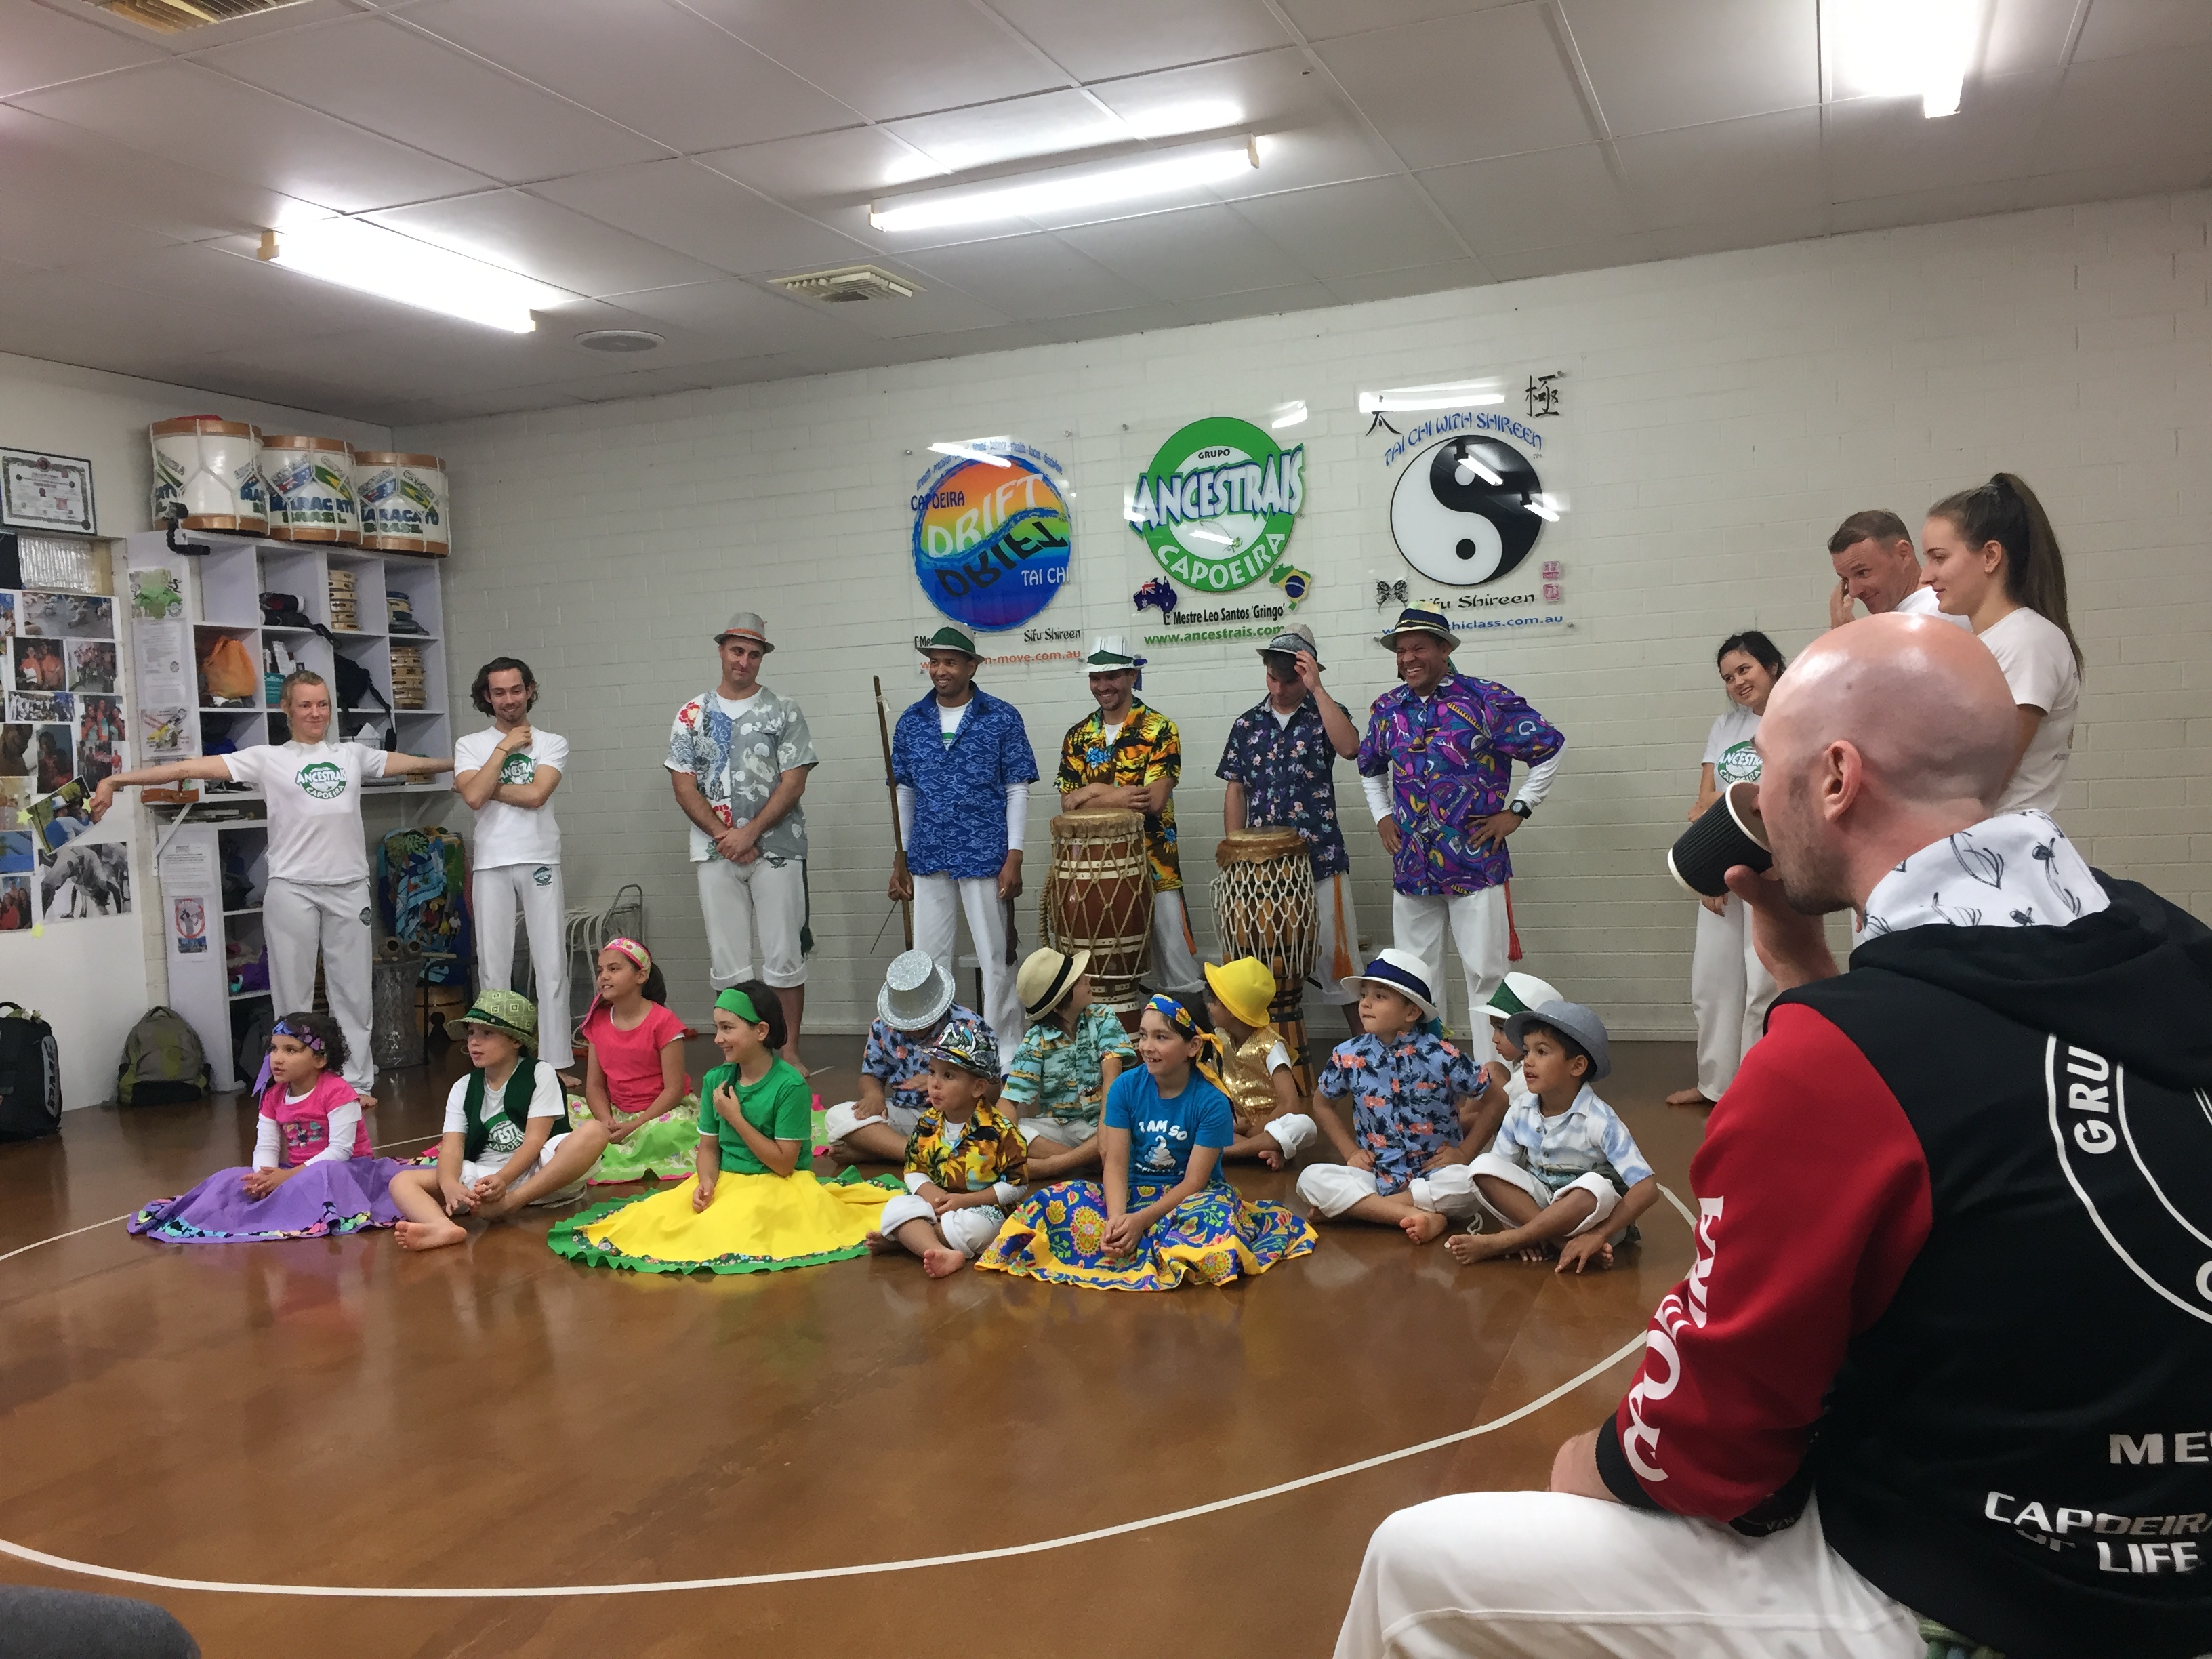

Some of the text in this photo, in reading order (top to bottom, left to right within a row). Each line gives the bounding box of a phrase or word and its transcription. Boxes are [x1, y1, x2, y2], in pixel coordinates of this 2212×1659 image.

[1525, 375, 1559, 417] 極
[1385, 434, 1405, 466] TAI
[1408, 420, 1431, 447] CHI
[1436, 412, 1472, 434] WITH
[1197, 449, 1231, 459] GRUPO
[1130, 445, 1305, 534] ANCESTRAIS
[910, 490, 965, 512] CAPOEIRA
[927, 474, 1044, 558] DRIFT
[1156, 533, 1286, 589] CAPOEIRA
[1021, 567, 1070, 586] TAI CHI
[1458, 594, 1536, 609] Shireen
[1173, 611, 1202, 626] Mestre
[1204, 609, 1219, 623] Leo
[1221, 607, 1250, 621] Santos
[1023, 626, 1081, 642] Sifu Shireen
[295, 769, 347, 785] ANCESTRAIS
[306, 785, 344, 799] CAPOEIRA
[1147, 1120, 1168, 1133] AM
[1168, 1125, 1187, 1141] SO
[2097, 1542, 2200, 1574] LIFE
